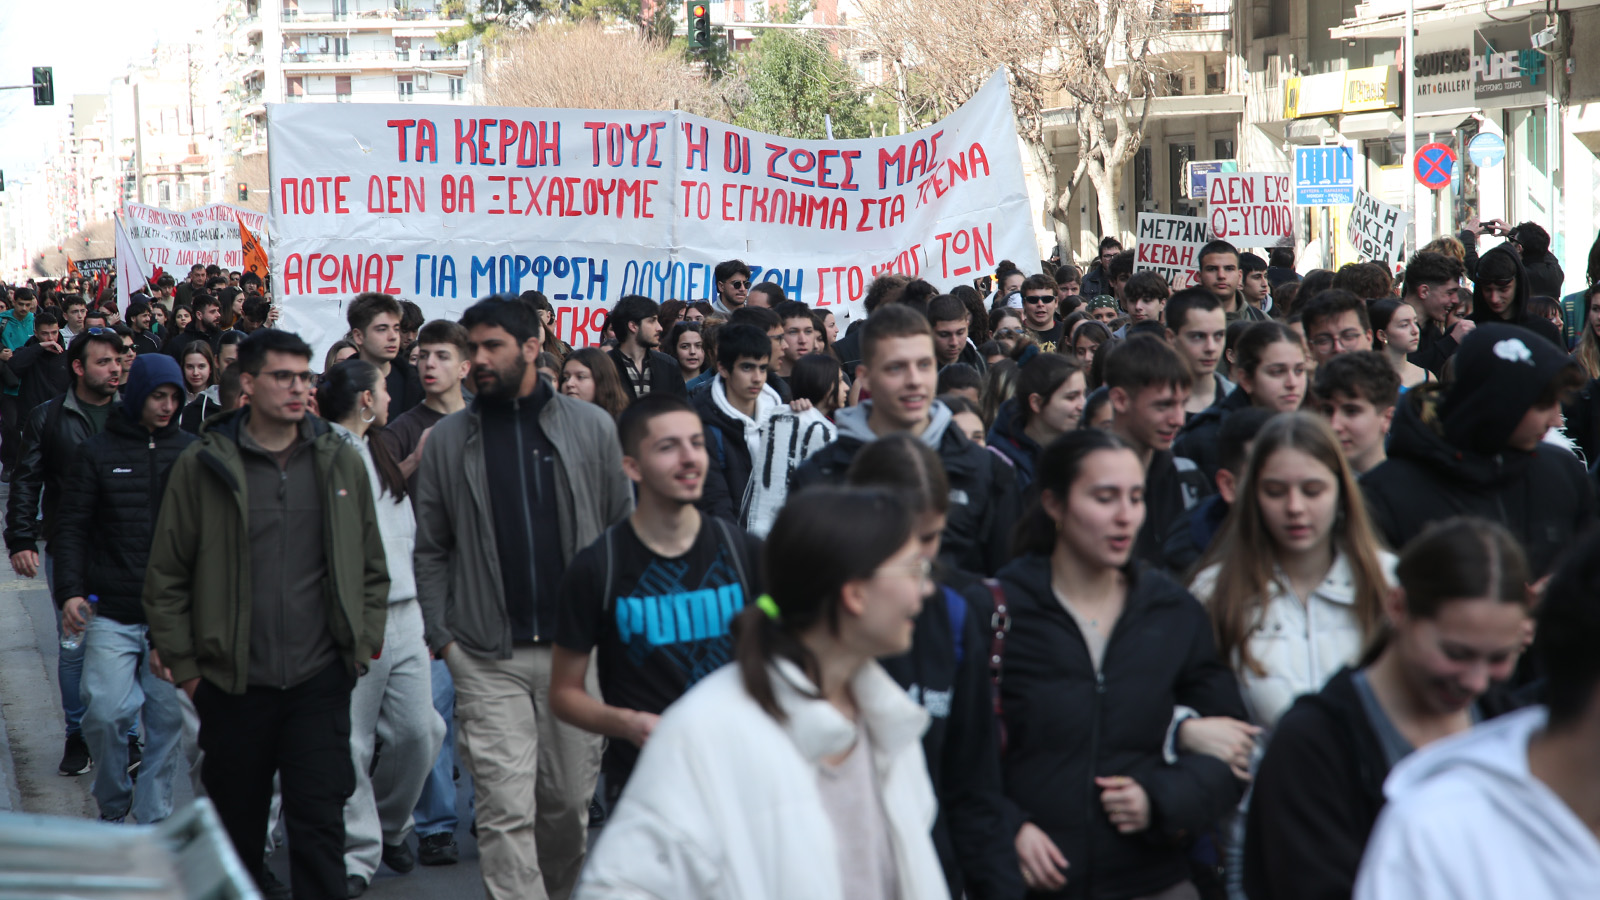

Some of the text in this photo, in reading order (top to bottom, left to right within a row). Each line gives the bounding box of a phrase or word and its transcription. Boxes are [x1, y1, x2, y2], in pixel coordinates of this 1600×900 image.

[1414, 48, 1470, 78] SOUTSOS
[1472, 50, 1521, 82] PURE
[1418, 79, 1471, 96] ART GALLERY
[387, 118, 438, 163] ΤΑ
[454, 118, 561, 168] ΚΕΡΔΗ
[584, 121, 666, 168] ΤΟΥΣ
[723, 131, 751, 175] ΟΙ
[765, 142, 862, 192] ΖΩΕΣ
[877, 129, 945, 190] ΜΑΣ
[281, 175, 351, 214] ΠΟΤΕ
[367, 174, 426, 214] ΔΕΝ
[441, 174, 475, 214] ΘΑ
[487, 176, 659, 219] ΞΕΧΑΣΟΥΜΕ
[681, 180, 711, 221] ΤΟ
[722, 184, 848, 231] ΕΓΚΛΗΜΑ
[855, 193, 906, 233] ΣΤΑ
[1210, 176, 1290, 205] ΔΕΝ ΕΧΩ
[1140, 218, 1209, 242] ΜΕΤΡΑΝ
[1212, 205, 1293, 238] ΟΞΥΓΟΝΟ
[1352, 206, 1393, 252] ΚΑΚΙΑ
[1384, 208, 1398, 228] Η
[148, 247, 171, 265] ΣΤΙΣ
[284, 252, 404, 295] ΑΓΩΝΑΣ
[415, 254, 457, 298] ΓΙΑ
[470, 254, 609, 301] ΜΟΡΦΩΣΗ
[620, 259, 718, 303] ΔΟΥΛΕΙ
[816, 266, 864, 307] ΣΤΟ
[935, 222, 995, 280] ΤΩΝ
[1137, 243, 1194, 266] ΚΕΡΔΗ
[615, 581, 745, 646] PUMA
